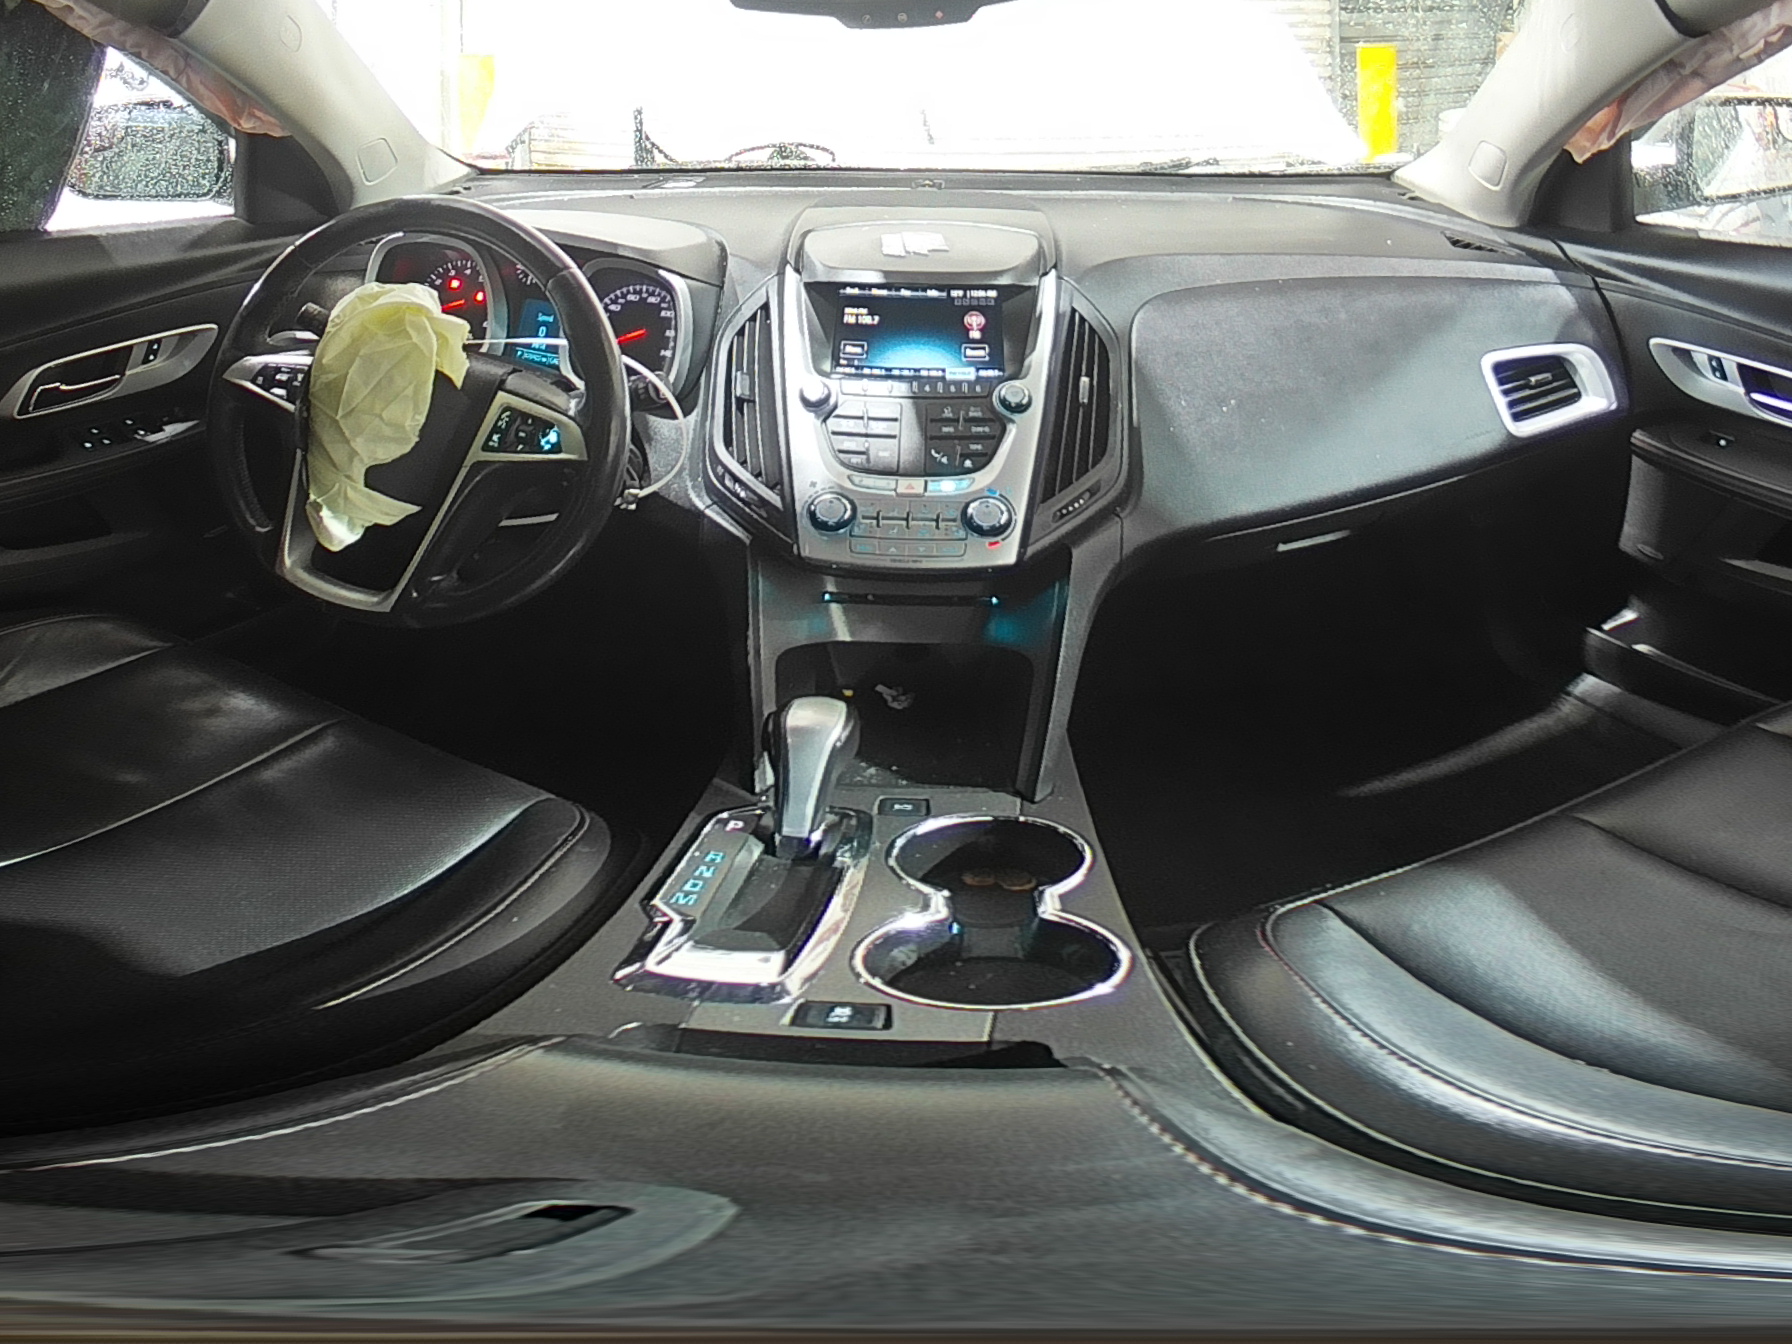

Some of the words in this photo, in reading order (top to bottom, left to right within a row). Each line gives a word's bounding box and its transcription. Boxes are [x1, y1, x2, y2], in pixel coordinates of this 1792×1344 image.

[725, 820, 744, 831] P
[704, 851, 724, 863] R
[693, 865, 716, 878] N
[682, 878, 704, 891] D
[669, 892, 698, 905] M
